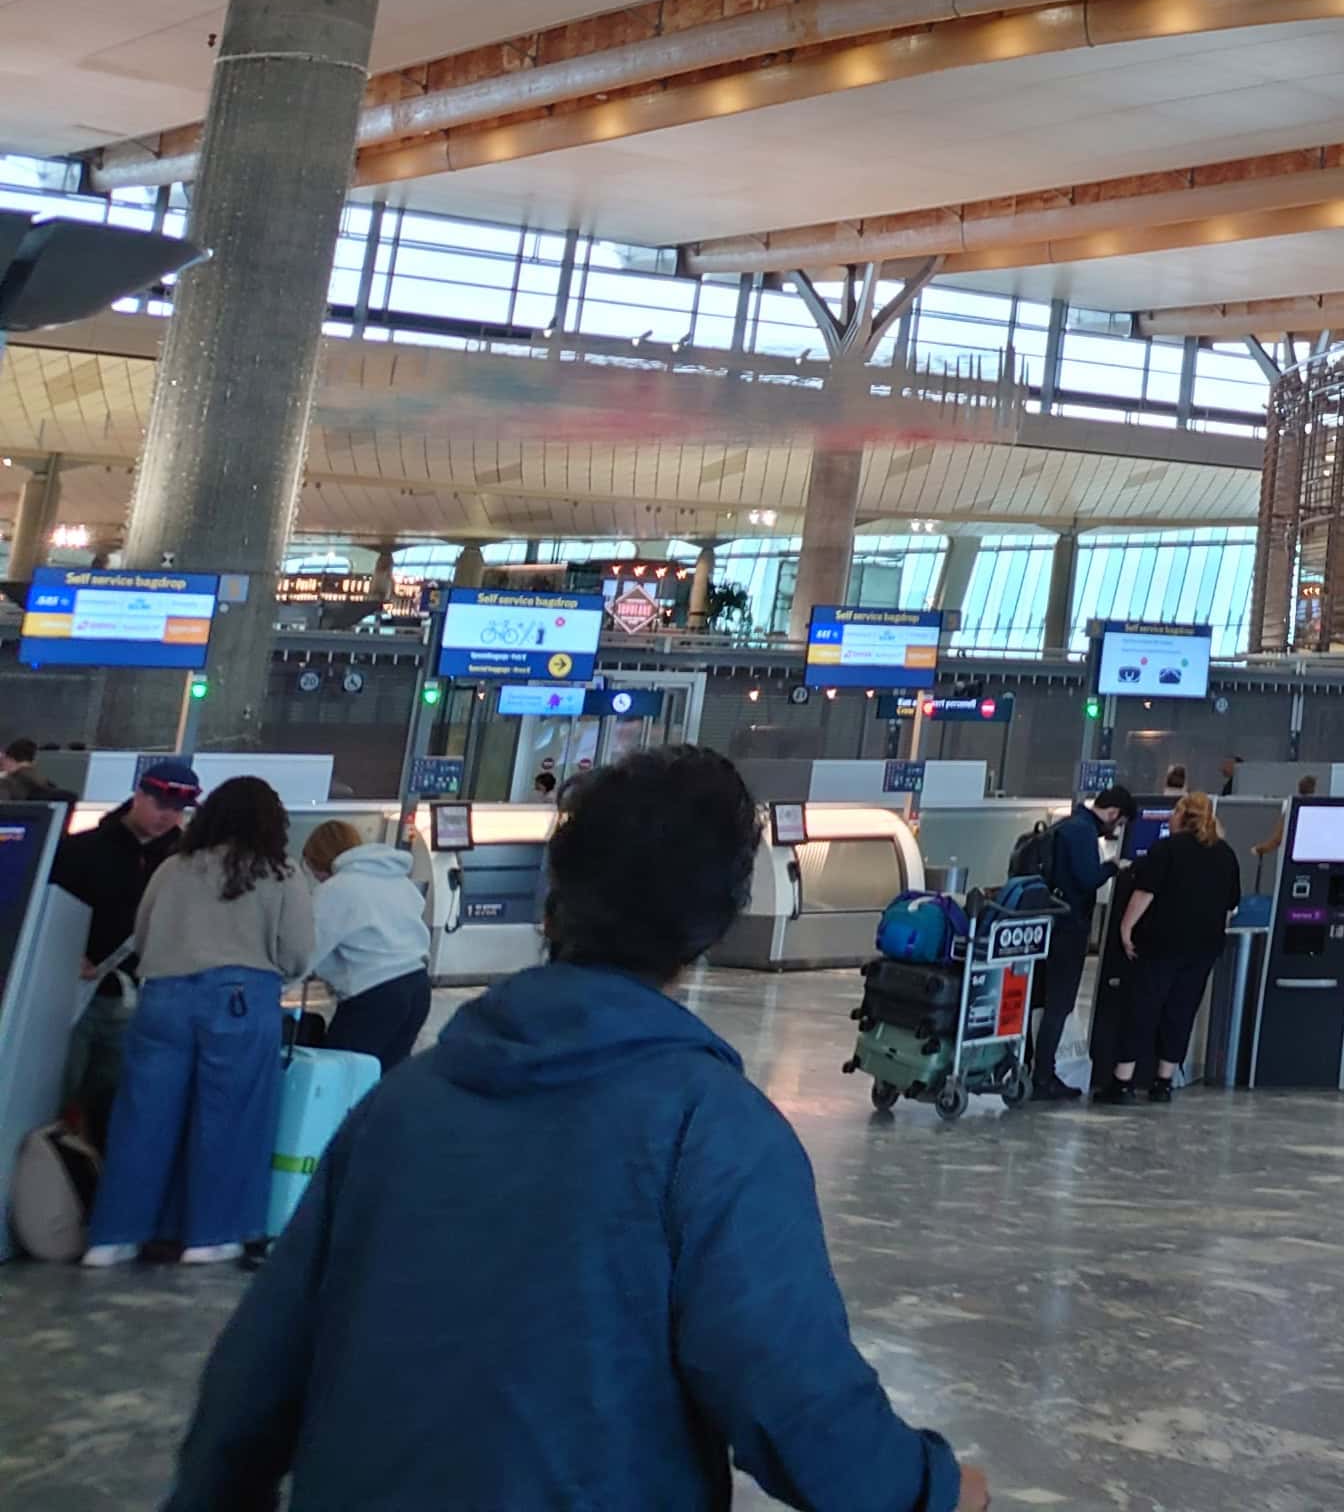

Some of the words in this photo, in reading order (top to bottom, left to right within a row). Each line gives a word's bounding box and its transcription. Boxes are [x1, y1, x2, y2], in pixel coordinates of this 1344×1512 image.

[65, 572, 91, 585] Self
[92, 575, 133, 587] service
[135, 574, 187, 590] bagdrop
[477, 592, 498, 604] Self
[499, 594, 534, 606] service
[535, 595, 578, 609] bagdrop
[835, 609, 854, 621] Self
[854, 612, 882, 622] service
